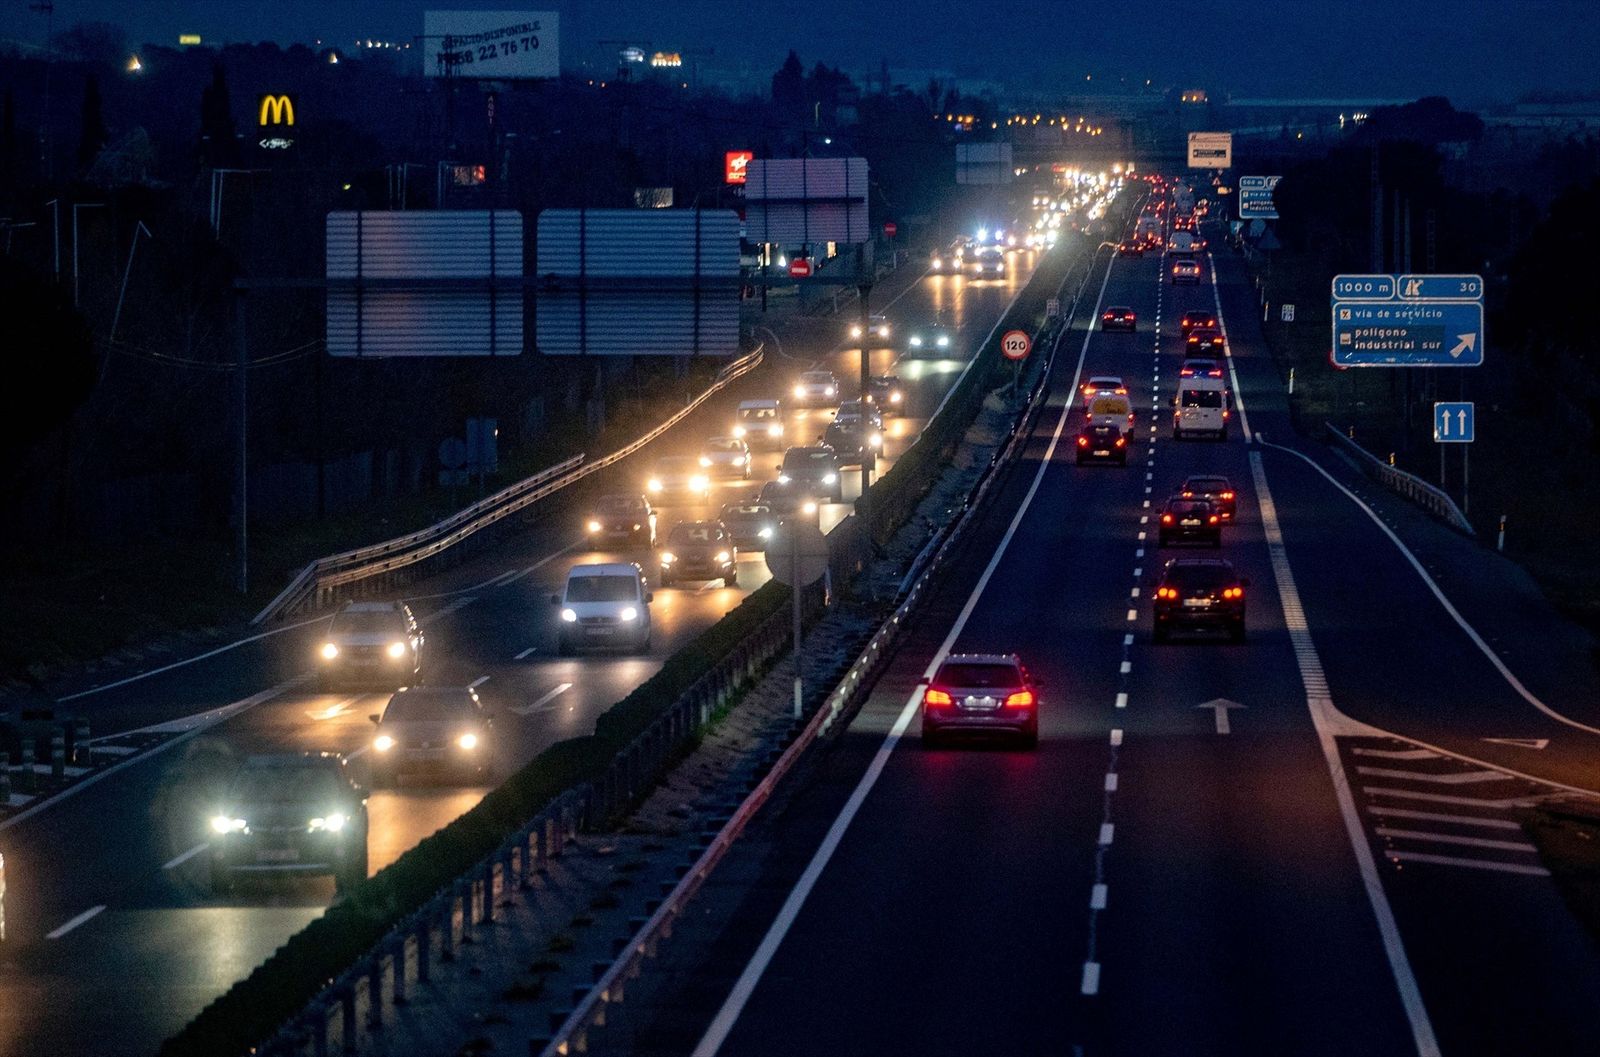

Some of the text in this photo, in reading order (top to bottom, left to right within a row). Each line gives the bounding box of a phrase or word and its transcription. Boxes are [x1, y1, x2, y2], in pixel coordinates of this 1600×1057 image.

[478, 44, 498, 61] 22
[500, 40, 518, 56] 76
[520, 35, 539, 52] 70
[260, 95, 295, 127] M
[1339, 282, 1373, 292] 1000
[1460, 282, 1476, 292] 30
[1377, 309, 1390, 318] de
[1395, 308, 1443, 318] servicio
[1006, 340, 1026, 350] 120
[1355, 340, 1442, 350] industrial sur
